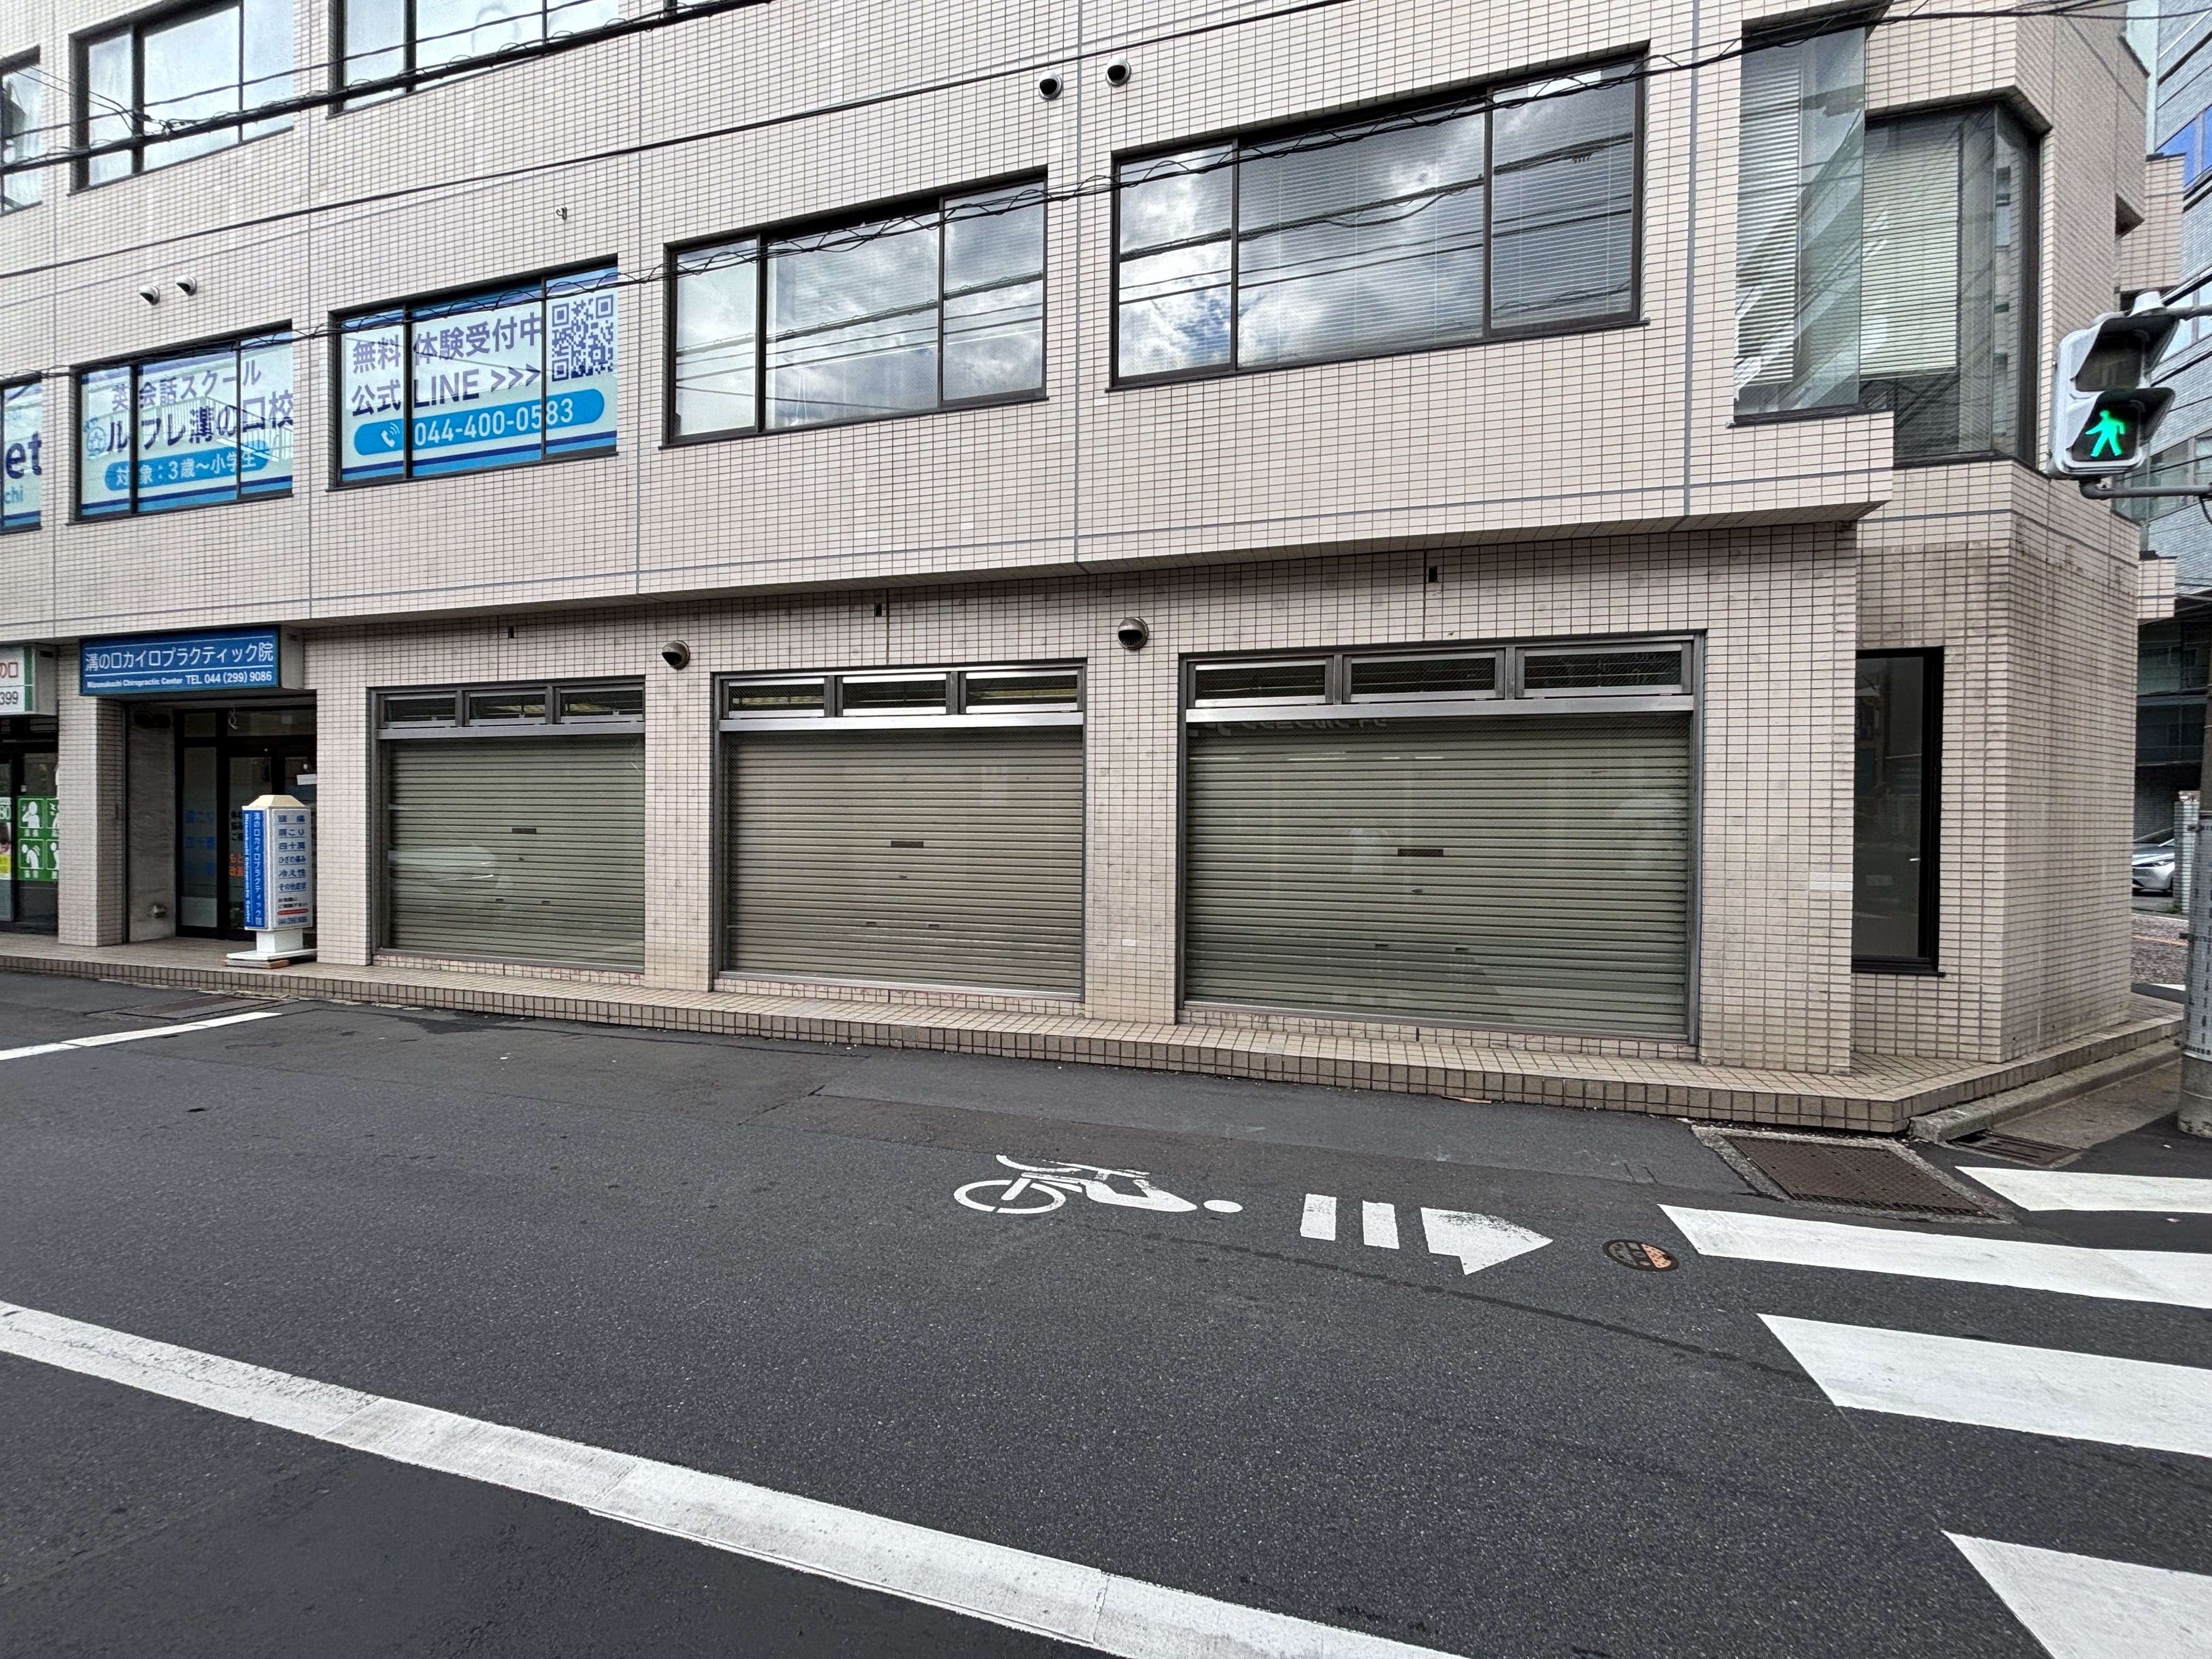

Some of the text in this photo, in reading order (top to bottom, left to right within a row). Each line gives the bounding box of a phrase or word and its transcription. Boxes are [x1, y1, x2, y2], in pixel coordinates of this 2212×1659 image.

[352, 311, 542, 374] 無料体験受付中
[111, 359, 262, 412] 英会話スクール
[414, 397, 574, 447] 044-400-0583
[84, 641, 274, 672] 溝の口カイロプラクティック院
[161, 677, 183, 685] Center
[185, 675, 202, 685] TEL
[204, 674, 221, 684] 044
[223, 672, 248, 684] (299)
[249, 671, 273, 682] 9086
